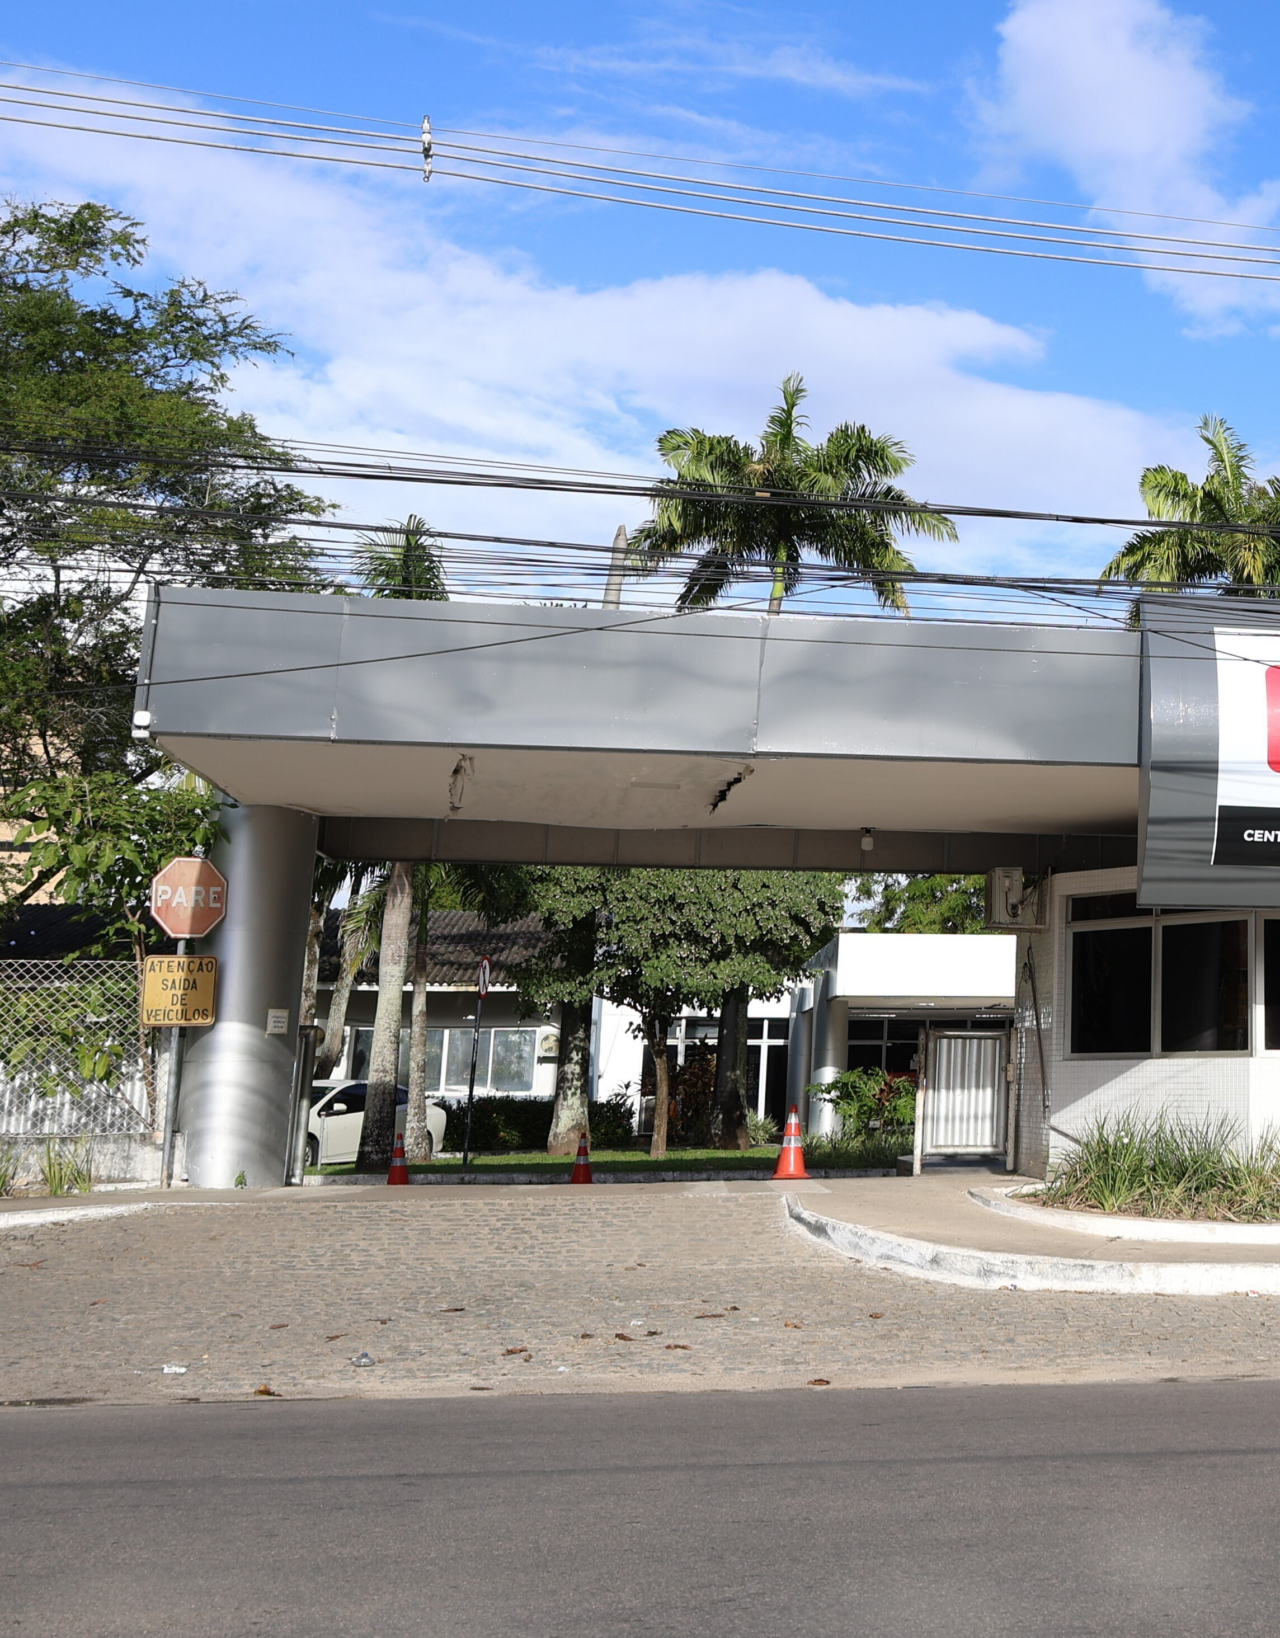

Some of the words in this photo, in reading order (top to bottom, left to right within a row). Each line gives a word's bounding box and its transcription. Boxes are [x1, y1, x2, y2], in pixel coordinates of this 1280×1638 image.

[157, 886, 221, 907] PARE
[148, 958, 214, 975] ATENÇÃO
[161, 975, 198, 991] SAÍDA
[171, 994, 188, 1006] DE
[146, 1007, 209, 1022] VEÍCULOS
